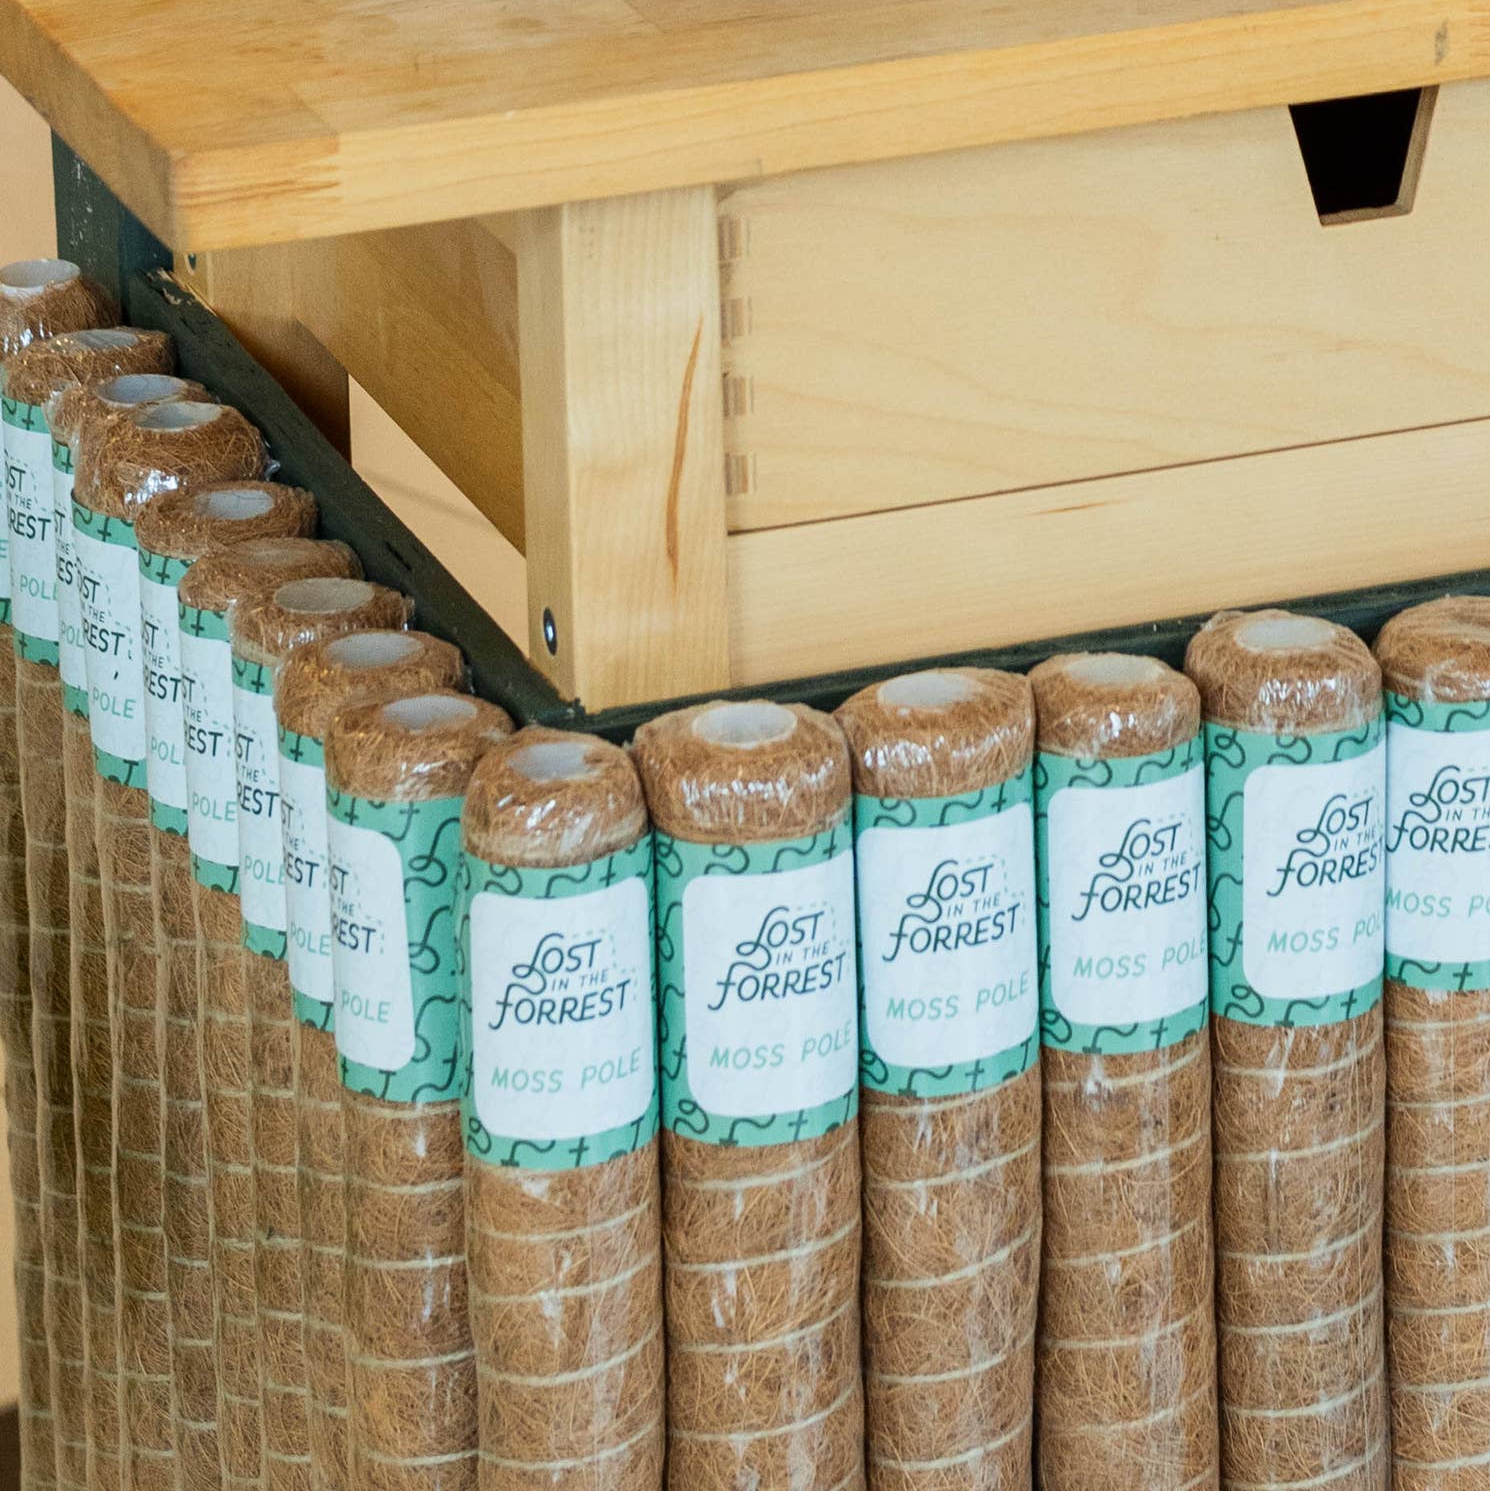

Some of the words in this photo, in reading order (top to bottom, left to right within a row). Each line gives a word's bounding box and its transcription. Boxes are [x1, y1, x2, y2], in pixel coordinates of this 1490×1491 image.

[61, 620, 84, 649] POL
[151, 736, 186, 765] POL
[1297, 794, 1373, 855] LOST
[1446, 807, 1464, 820] IN
[1100, 819, 1181, 879] LOST
[1334, 835, 1350, 849] IN
[1357, 827, 1376, 845] THE
[1138, 862, 1154, 876] IN
[1163, 854, 1187, 871] THE
[907, 860, 994, 919] LOST
[947, 902, 964, 916] IN
[974, 896, 1000, 912] THE
[1386, 893, 1452, 918] MOSS
[736, 906, 824, 965] LOST
[1267, 929, 1338, 954] MOSS
[512, 932, 602, 989] LOST
[776, 949, 794, 964] IN
[803, 941, 829, 960] THE
[1073, 955, 1146, 979] MOSS
[551, 976, 569, 991] IN
[579, 970, 608, 987] THE
[887, 996, 958, 1021] MOSS
[976, 970, 1029, 1010] POLE
[709, 1044, 784, 1069] MOSS
[801, 1020, 851, 1061] POLE
[490, 1067, 563, 1093] MOSS
[581, 1047, 641, 1090] POLE
